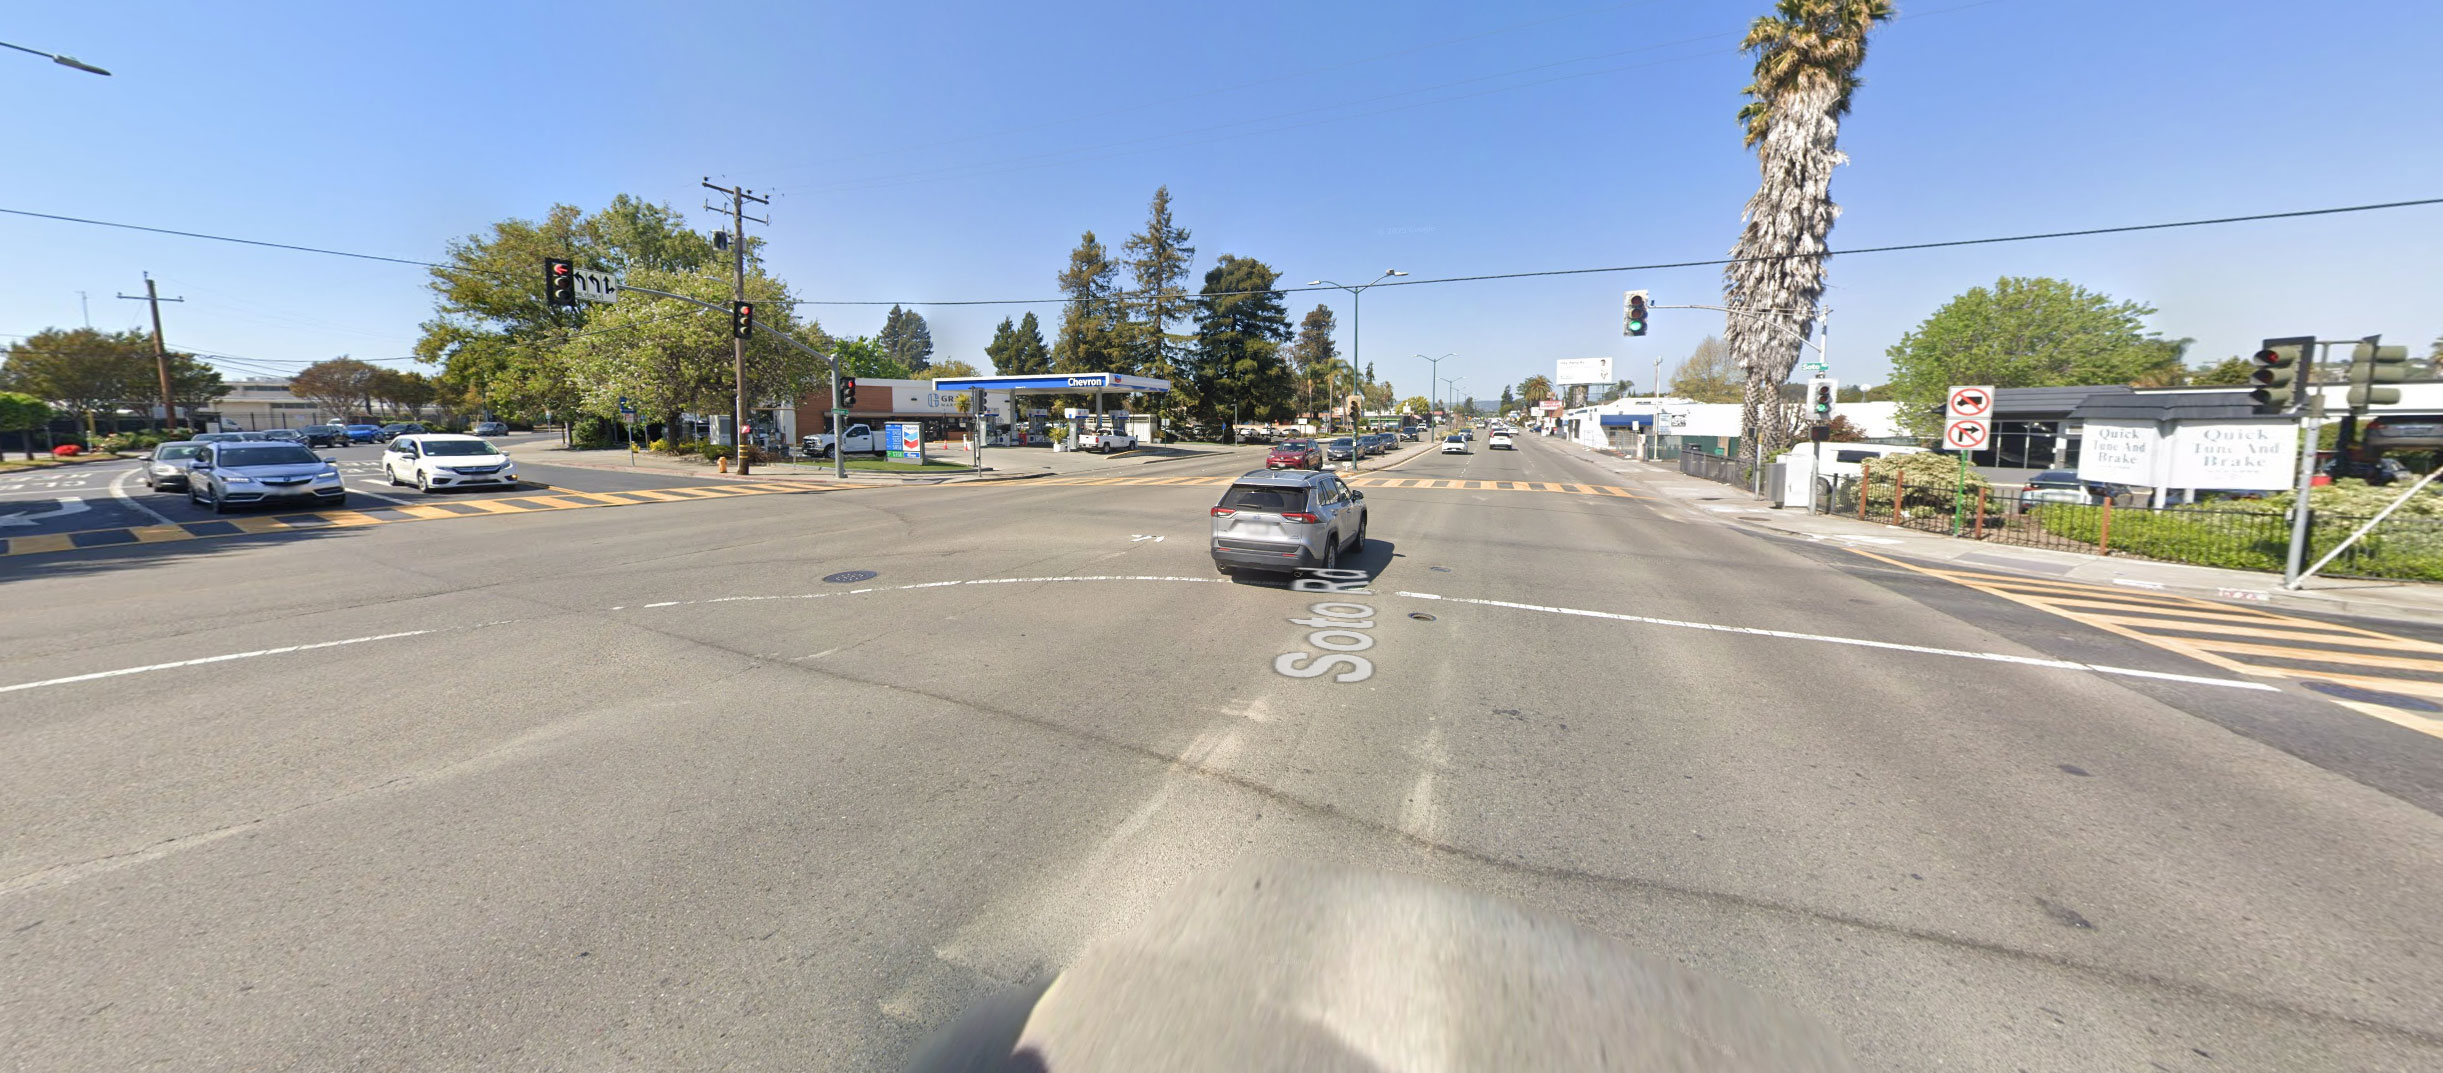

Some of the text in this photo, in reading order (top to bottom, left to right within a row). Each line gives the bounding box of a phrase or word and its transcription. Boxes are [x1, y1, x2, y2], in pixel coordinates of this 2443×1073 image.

[1068, 378, 1102, 387] Chevron
[2099, 428, 2140, 440] Quick
[2203, 428, 2269, 443] Quick
[2125, 442, 2146, 453] And
[2098, 451, 2138, 464] Brake
[2203, 456, 2267, 467] Brake
